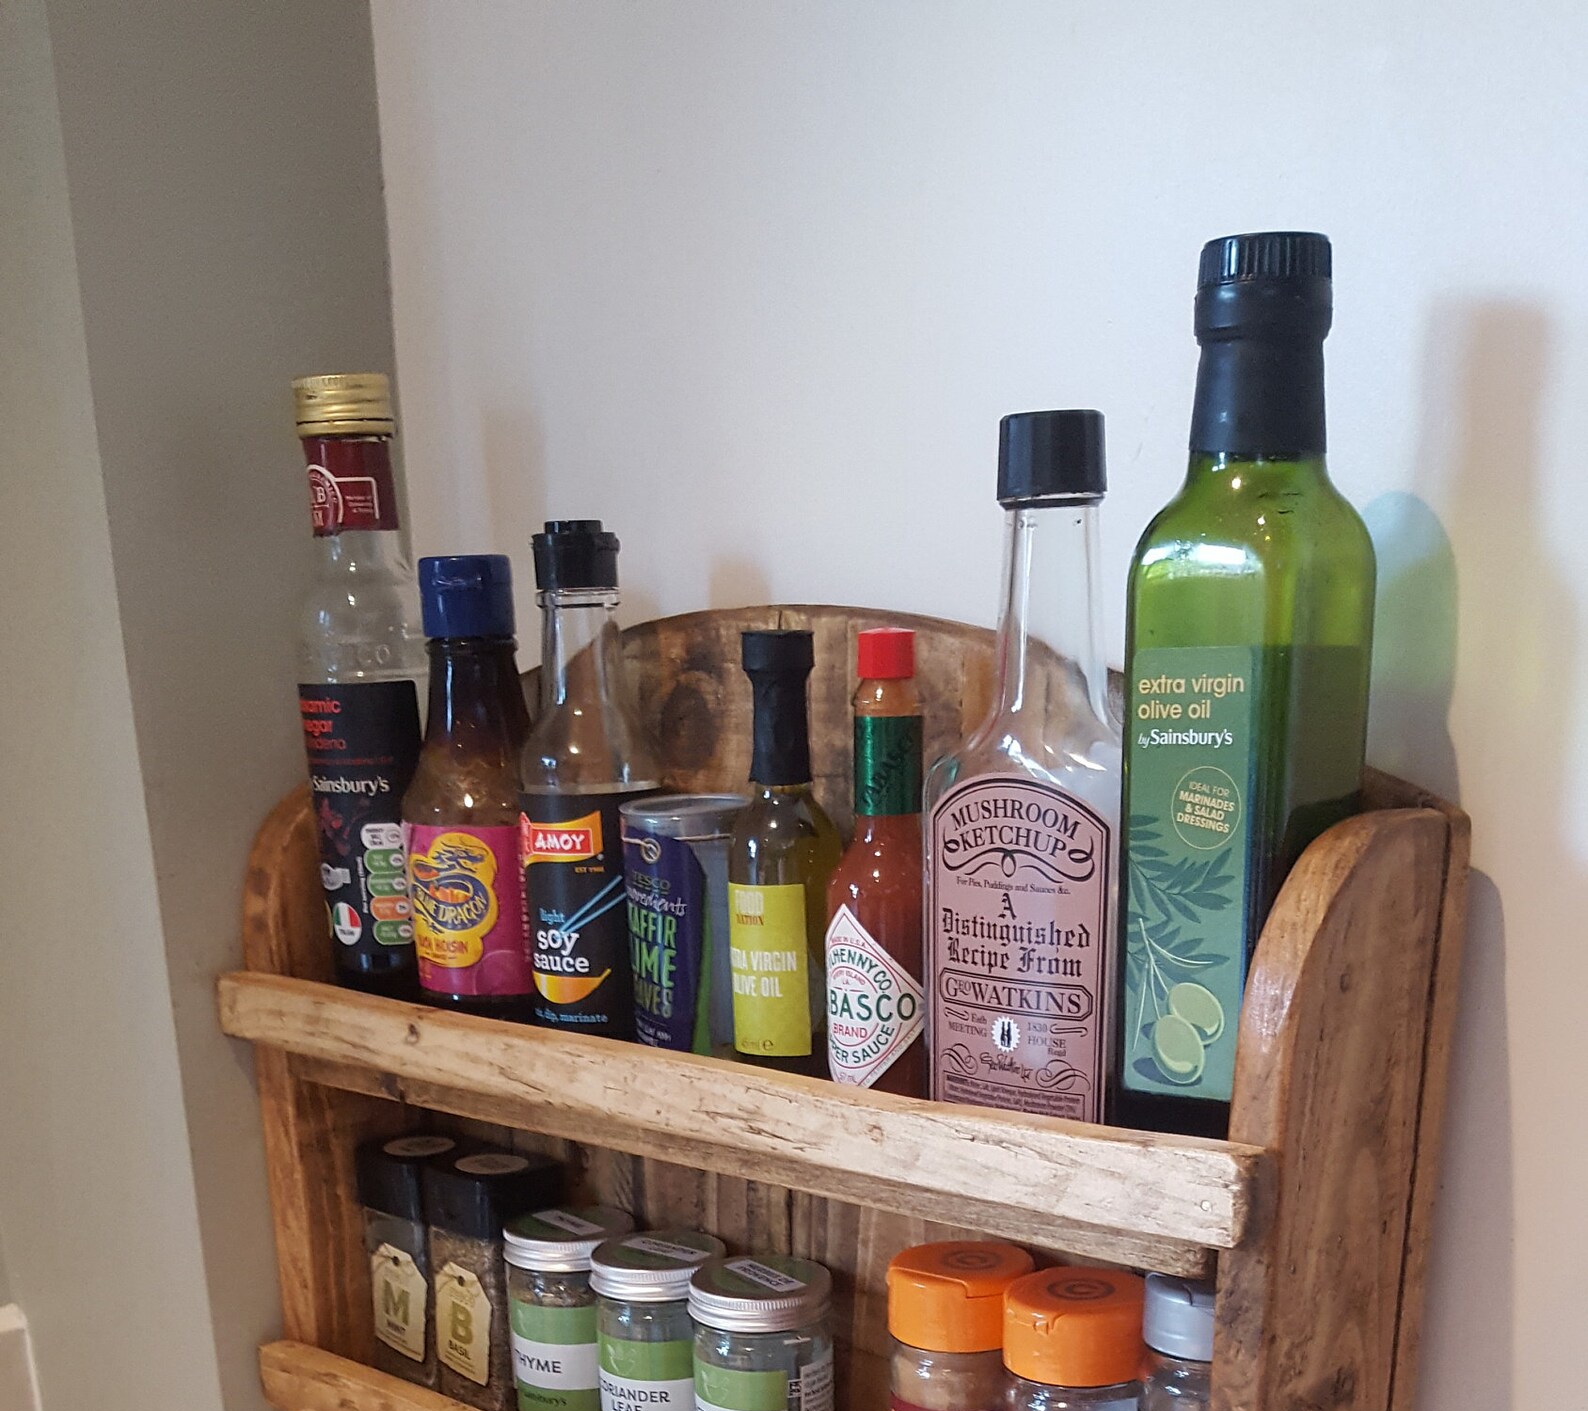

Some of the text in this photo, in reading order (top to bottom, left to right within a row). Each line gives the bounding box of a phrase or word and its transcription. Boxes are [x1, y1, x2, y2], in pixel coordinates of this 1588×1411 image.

[1138, 673, 1245, 698] extra virgin
[1137, 699, 1211, 720] olive oil
[1137, 728, 1233, 749] by Sainsbury's
[312, 775, 391, 797] Sainsbury's
[1188, 781, 1230, 798] IDEAL FOR
[1178, 789, 1235, 812] MARINADES
[1193, 804, 1225, 821] SALAD
[951, 798, 1081, 841] MUSHROOM
[1176, 812, 1230, 834] DRESSINGS
[534, 830, 586, 852] AMOY
[959, 825, 1067, 858] KETCHUP
[956, 876, 967, 885] For
[984, 879, 1014, 892] Puddings
[438, 891, 489, 926] DRAGON
[538, 907, 567, 925] light
[998, 892, 1018, 920] A
[942, 907, 1091, 948] Distinguished
[536, 928, 580, 956] soy
[533, 951, 590, 974] sauce
[750, 950, 798, 972] VIRGIN
[947, 936, 1083, 978] Recipe From
[760, 976, 784, 998] OIL
[971, 982, 1082, 1016] WATKINS
[828, 988, 917, 1022] BASCO
[832, 1022, 868, 1039] BRAND
[948, 1021, 1067, 1050] MEETING HOUSE
[853, 1023, 896, 1064] SAUCE
[383, 1278, 410, 1328] M
[450, 1300, 473, 1346] B
[600, 1378, 671, 1404] ORIANDER
